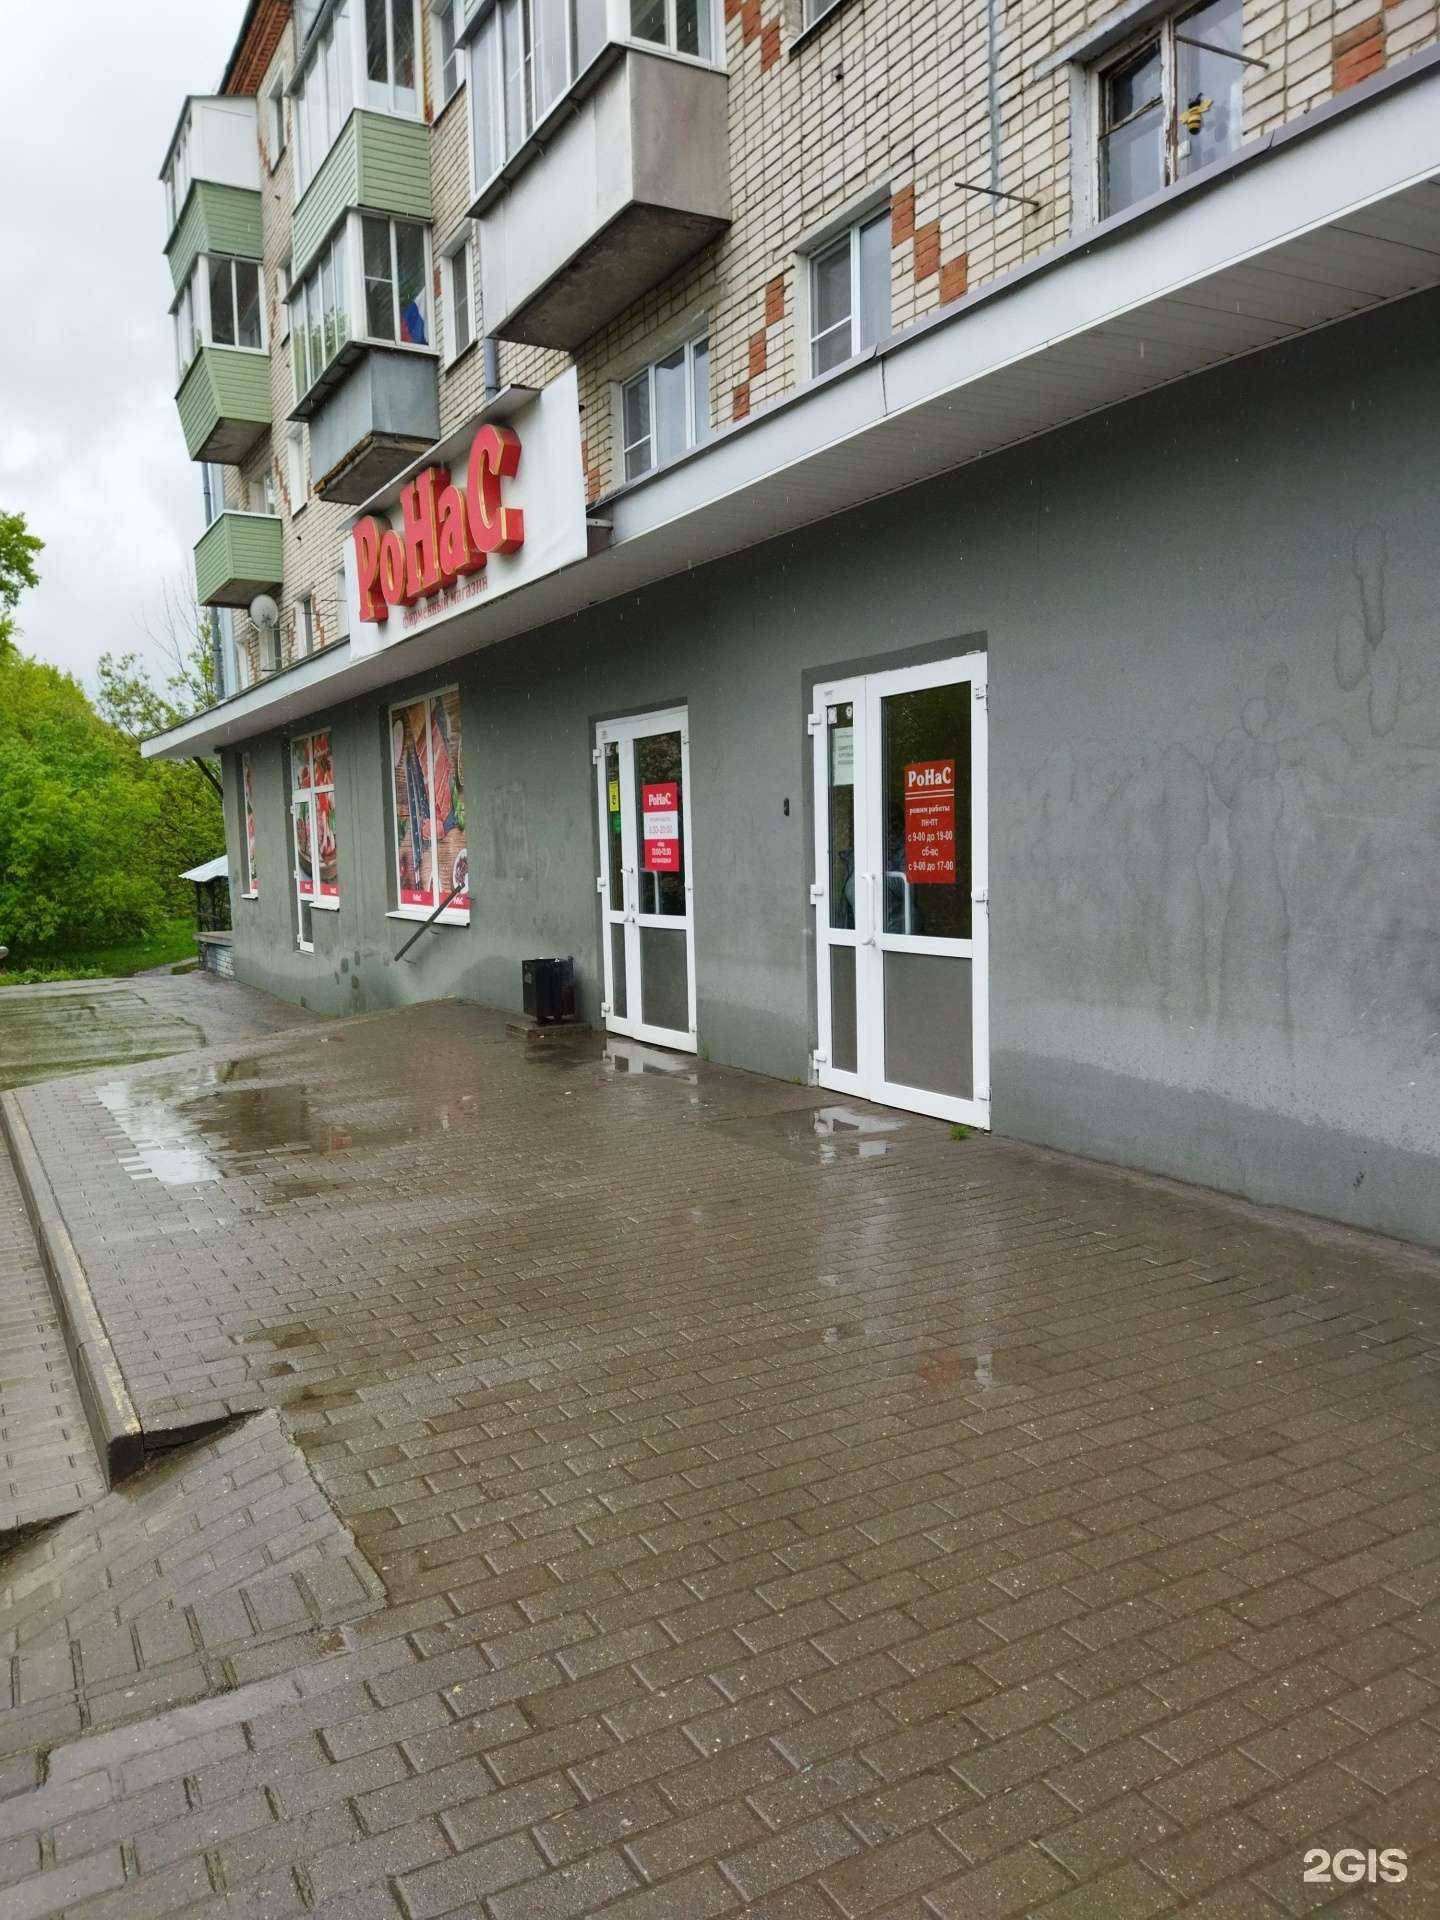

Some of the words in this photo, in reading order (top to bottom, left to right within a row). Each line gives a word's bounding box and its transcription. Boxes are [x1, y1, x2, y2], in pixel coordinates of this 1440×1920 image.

[352, 423, 525, 623] РоНаС
[908, 766, 952, 787] РоНаС
[921, 818, 938, 827] пн-пт
[912, 831, 926, 842] 9-00
[926, 833, 936, 843] до
[936, 830, 953, 841] 19-00
[921, 846, 939, 856] сб-вс
[926, 863, 936, 872] до
[937, 860, 954, 871] 17-00
